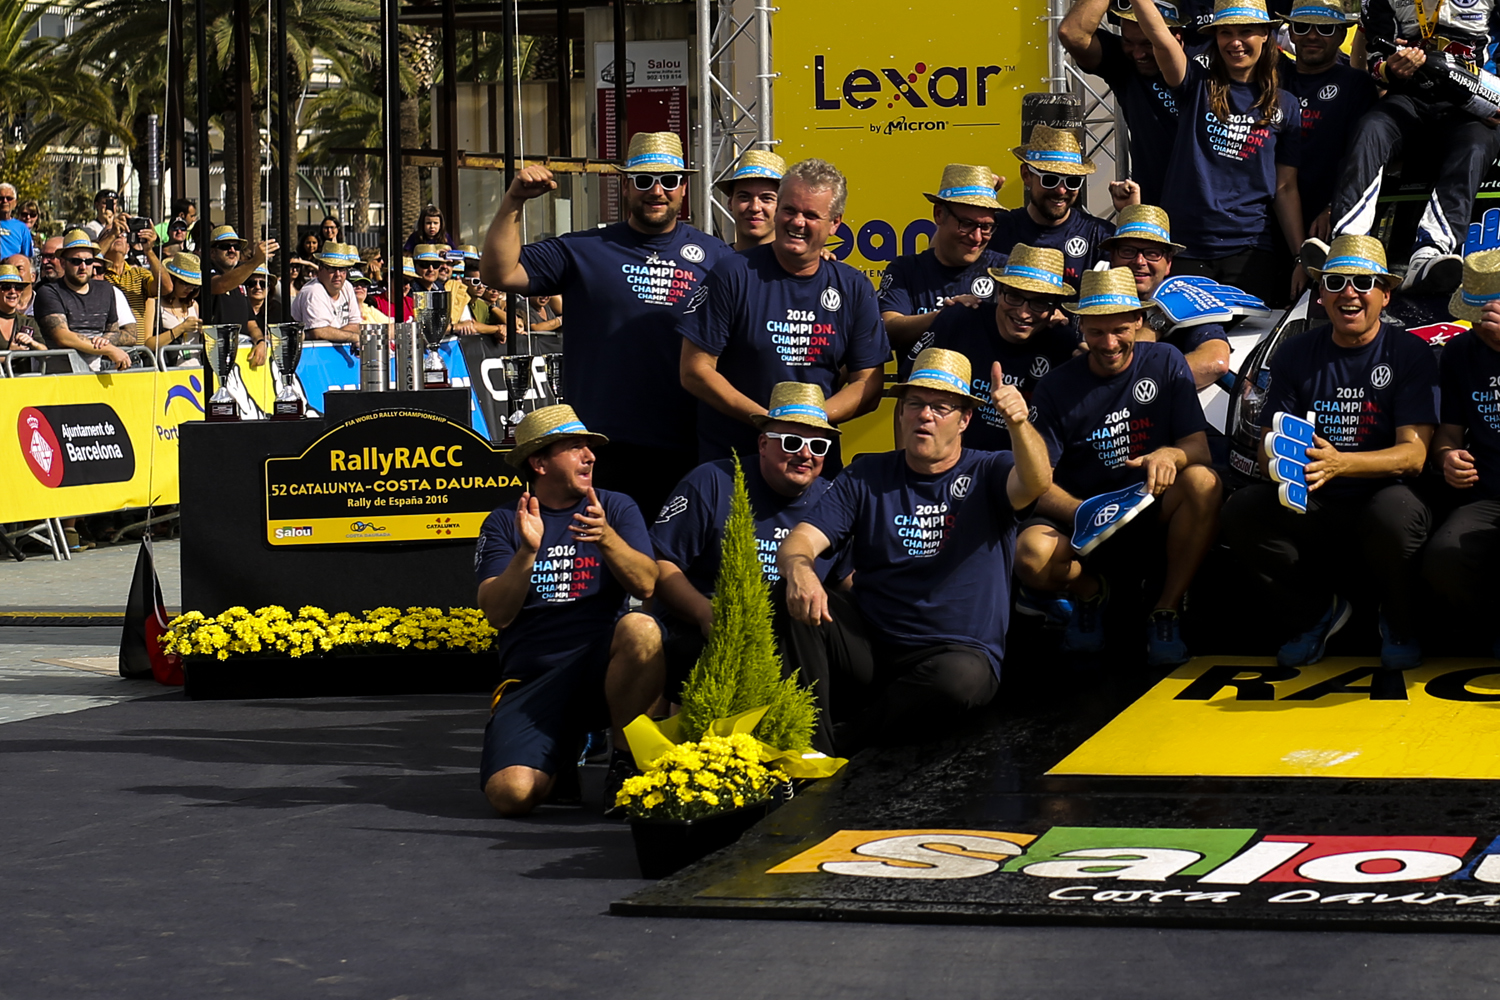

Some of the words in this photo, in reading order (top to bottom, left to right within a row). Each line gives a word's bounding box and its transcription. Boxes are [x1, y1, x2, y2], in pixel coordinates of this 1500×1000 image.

[647, 59, 681, 69] Salou
[814, 55, 1003, 112] Lexar
[869, 123, 881, 135] by
[786, 309, 816, 322] 2016
[1336, 387, 1364, 399] 2016
[62, 422, 104, 441] Ajuntament
[105, 421, 115, 436] de
[65, 441, 123, 462] Barcelona
[330, 445, 463, 476] RallyRACC
[271, 484, 288, 496] 52
[435, 475, 523, 490] DAURADA
[347, 498, 372, 509] Rally
[374, 496, 386, 506] de
[389, 495, 423, 508] España
[425, 494, 449, 505] 2016
[1047, 885, 1238, 904] Costa
